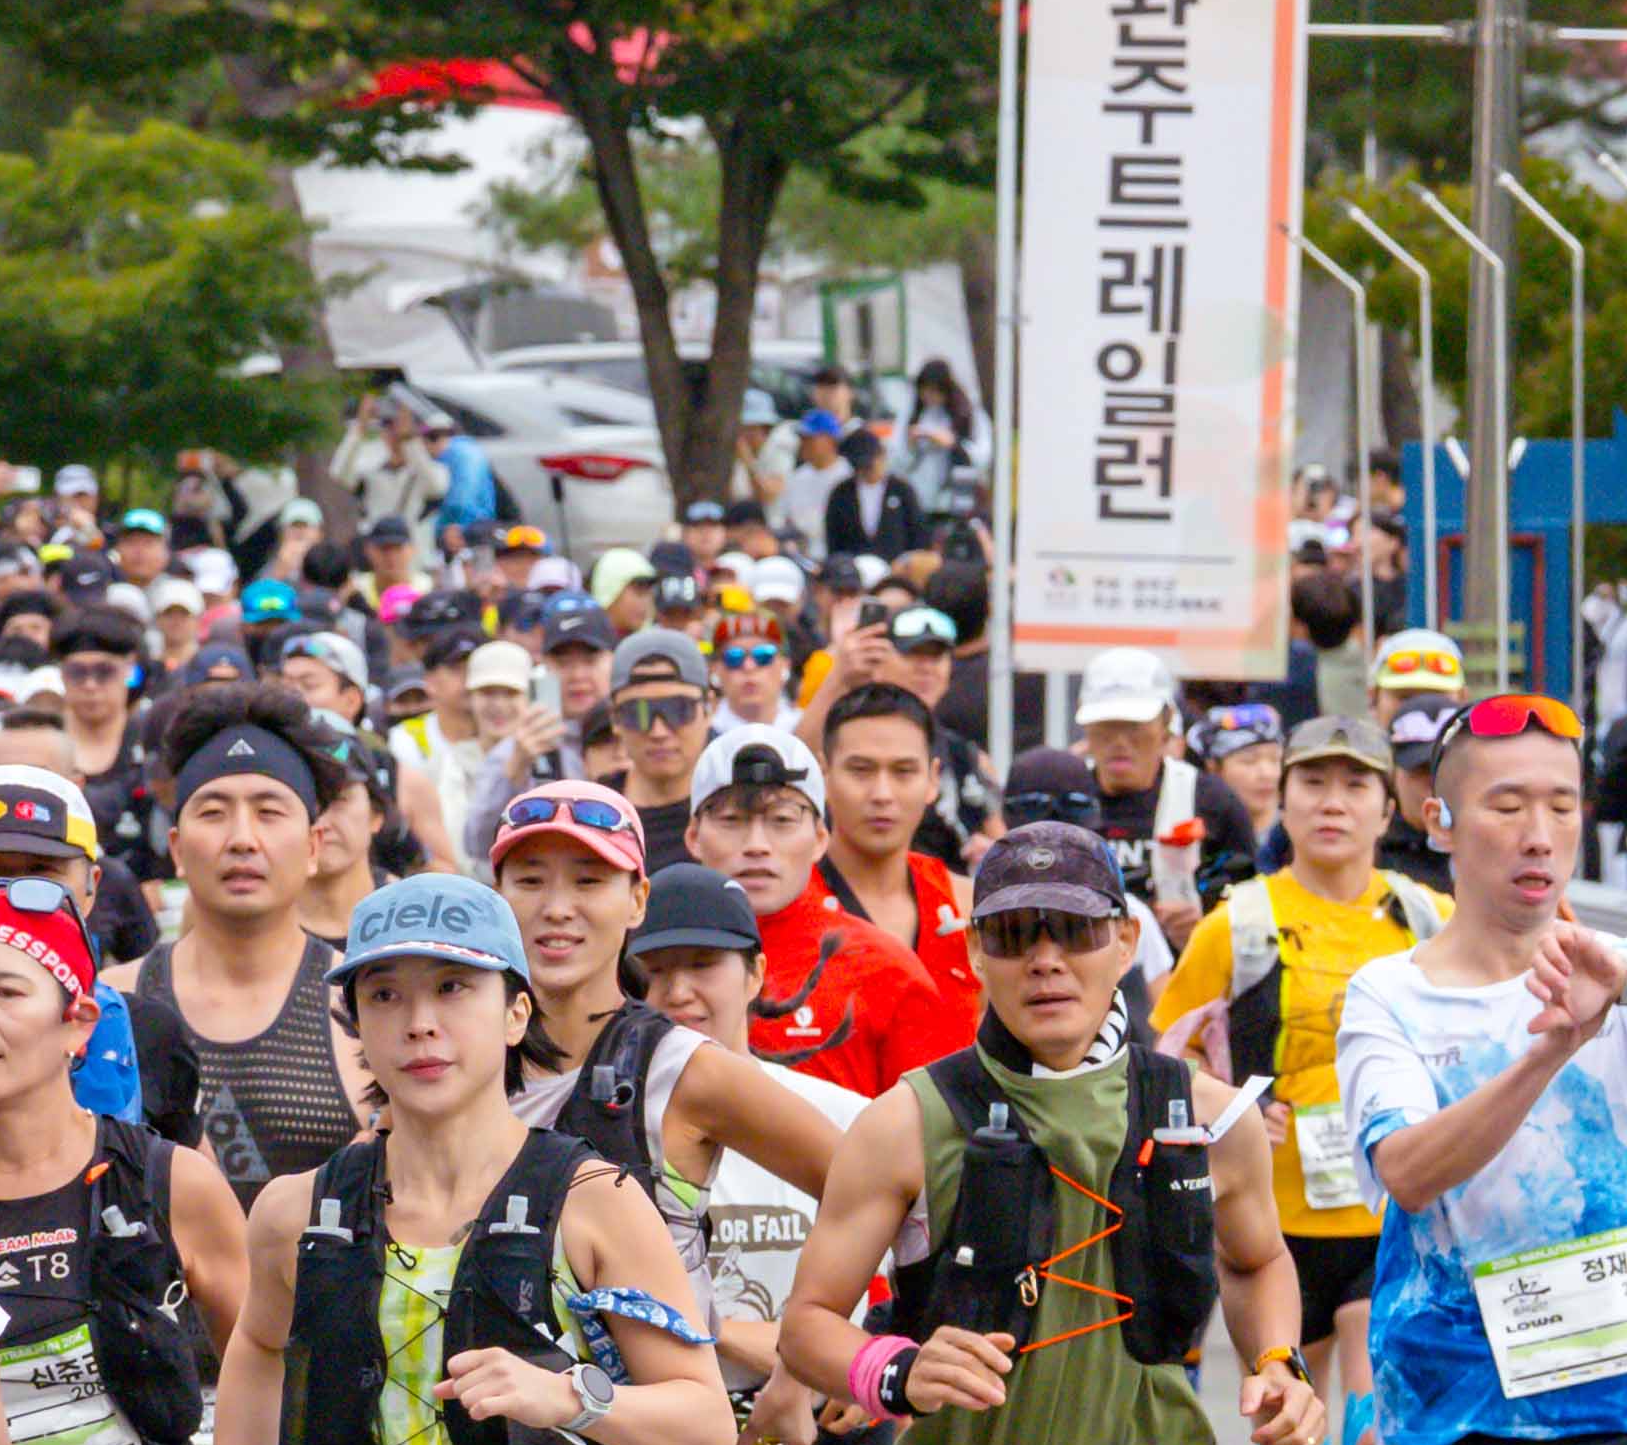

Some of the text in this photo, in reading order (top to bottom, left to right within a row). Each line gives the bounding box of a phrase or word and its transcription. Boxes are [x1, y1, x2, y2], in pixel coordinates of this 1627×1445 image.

[359, 894, 472, 944] ciele
[718, 1213, 806, 1244] OR FAIL
[25, 1251, 71, 1283] T8
[1506, 1313, 1563, 1334] LOWA
